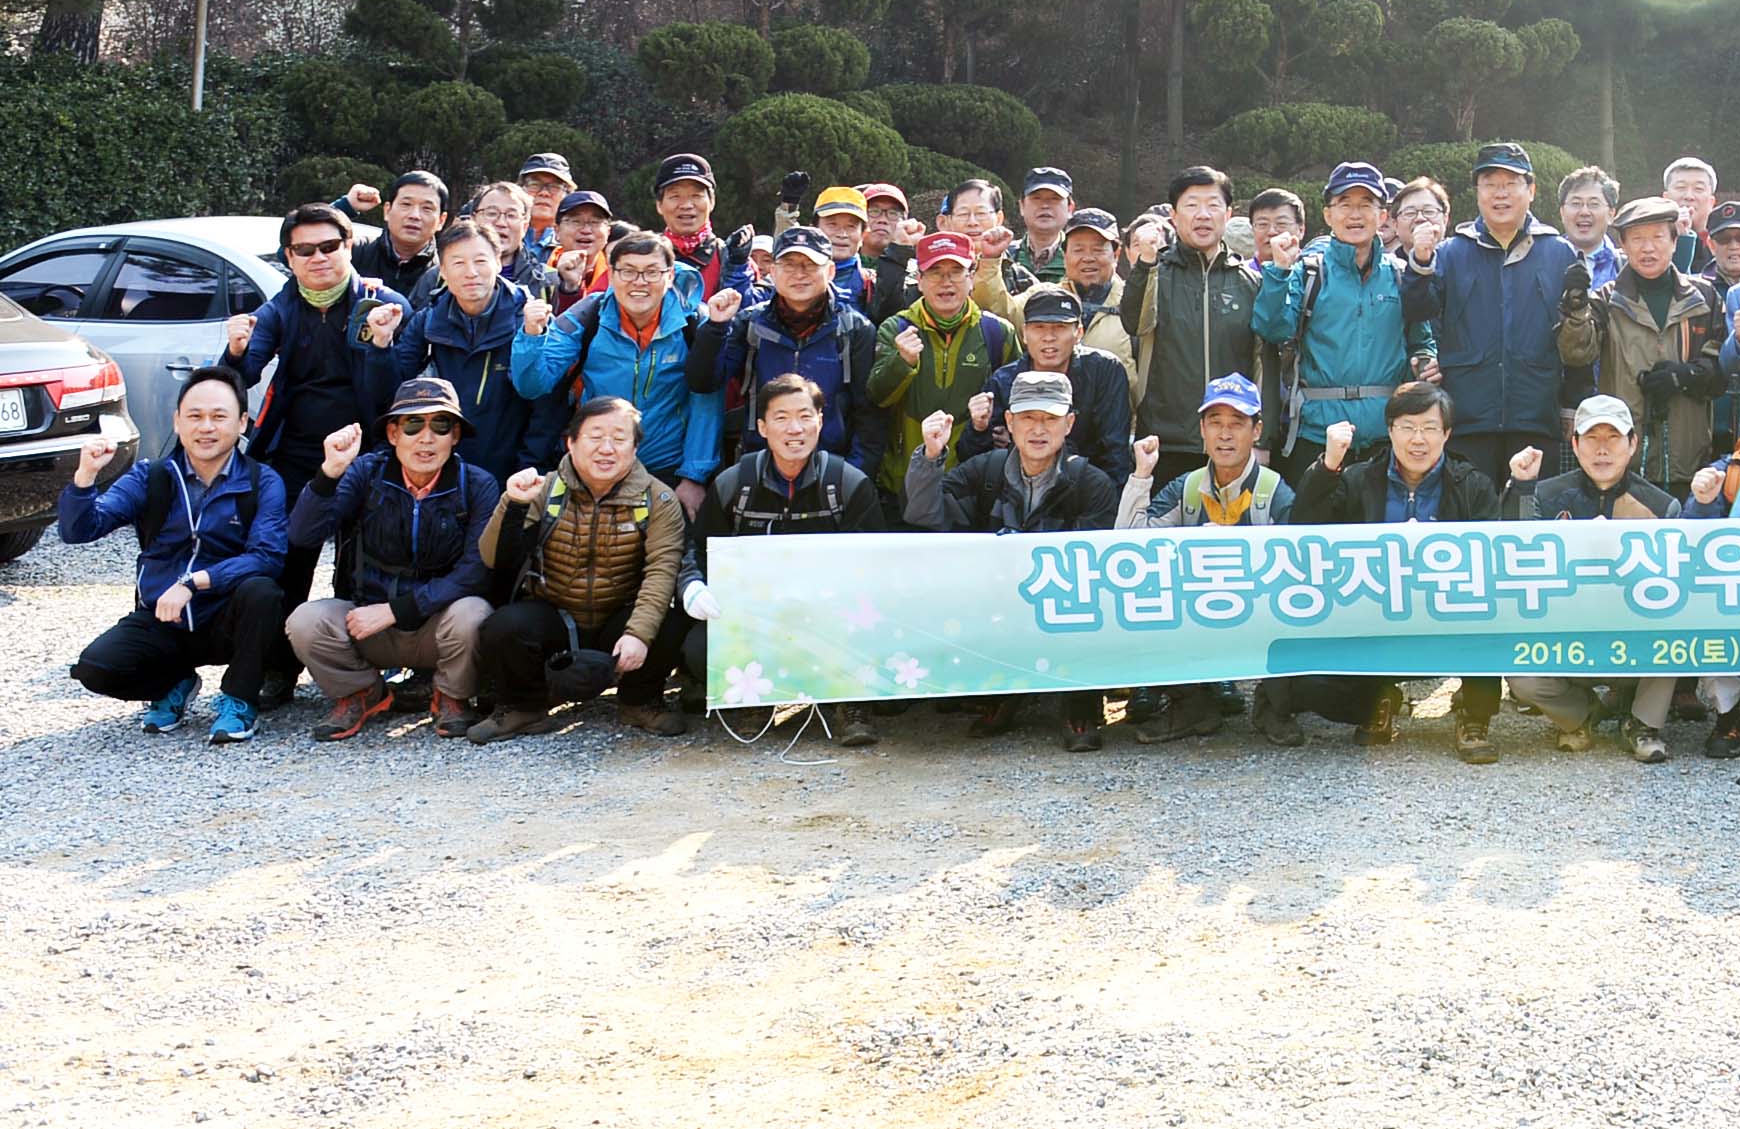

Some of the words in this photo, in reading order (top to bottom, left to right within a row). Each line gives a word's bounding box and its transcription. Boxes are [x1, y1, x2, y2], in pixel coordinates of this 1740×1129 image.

[1513, 641, 1595, 666] 2016.
[1609, 642, 1638, 666] 3.
[1652, 636, 1740, 668] 26(토)
